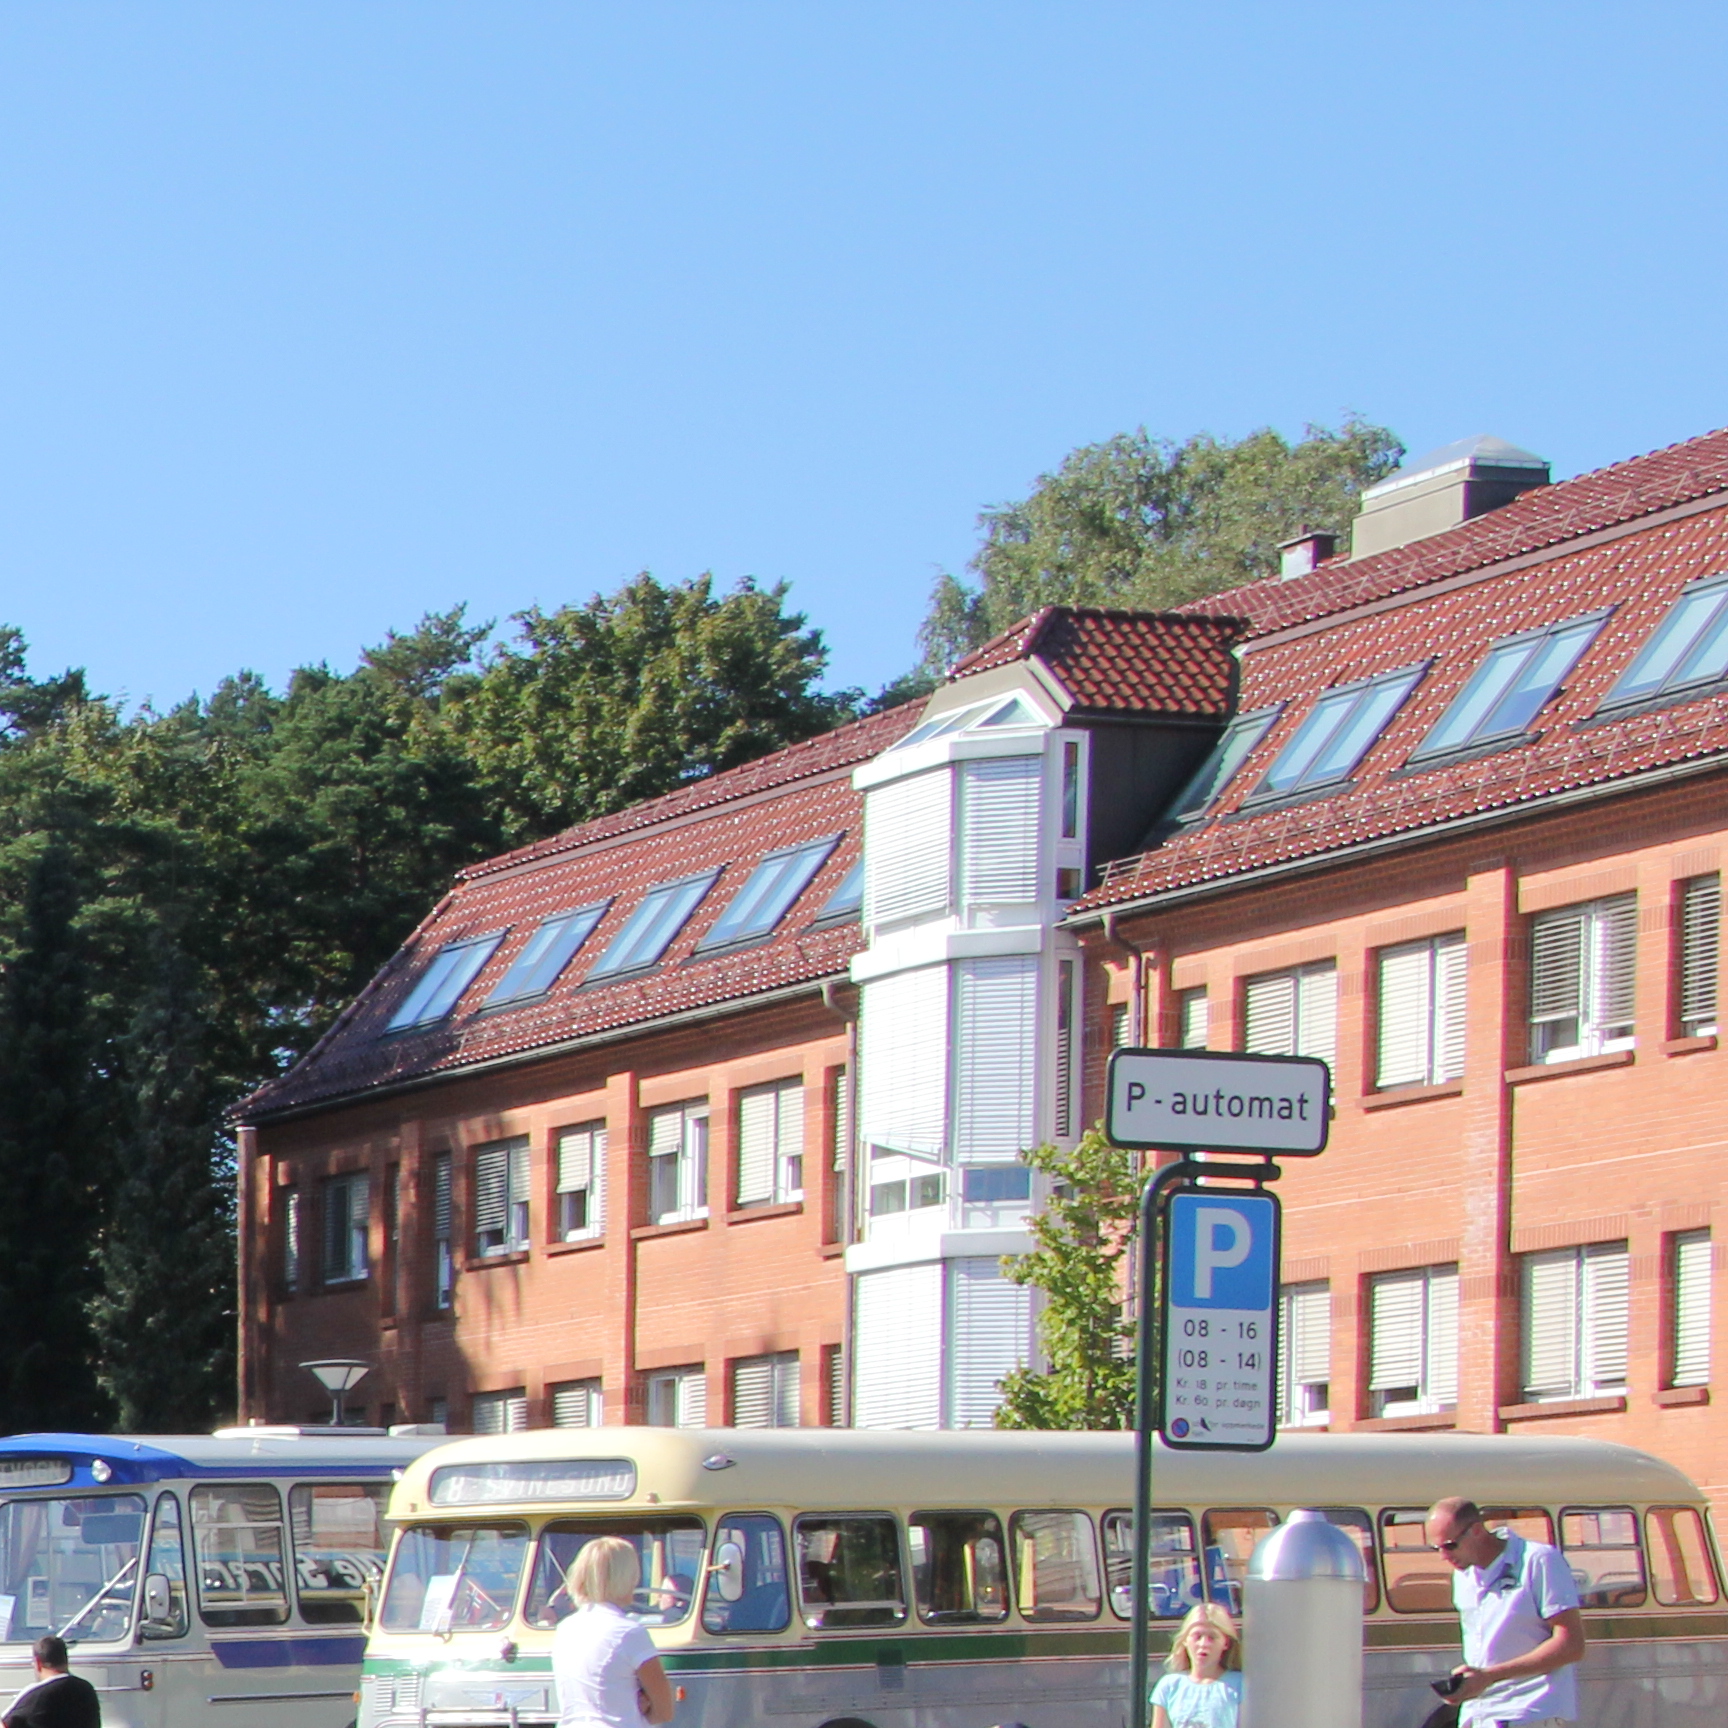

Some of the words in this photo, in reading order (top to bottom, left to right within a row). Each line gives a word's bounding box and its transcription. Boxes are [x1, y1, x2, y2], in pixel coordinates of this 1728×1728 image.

[1193, 1207, 1252, 1299] P
[1184, 1319, 1209, 1337] 08
[1238, 1322, 1257, 1339] 16
[1178, 1348, 1208, 1368] (08
[1238, 1352, 1261, 1372] 14)
[1234, 1381, 1258, 1391] time
